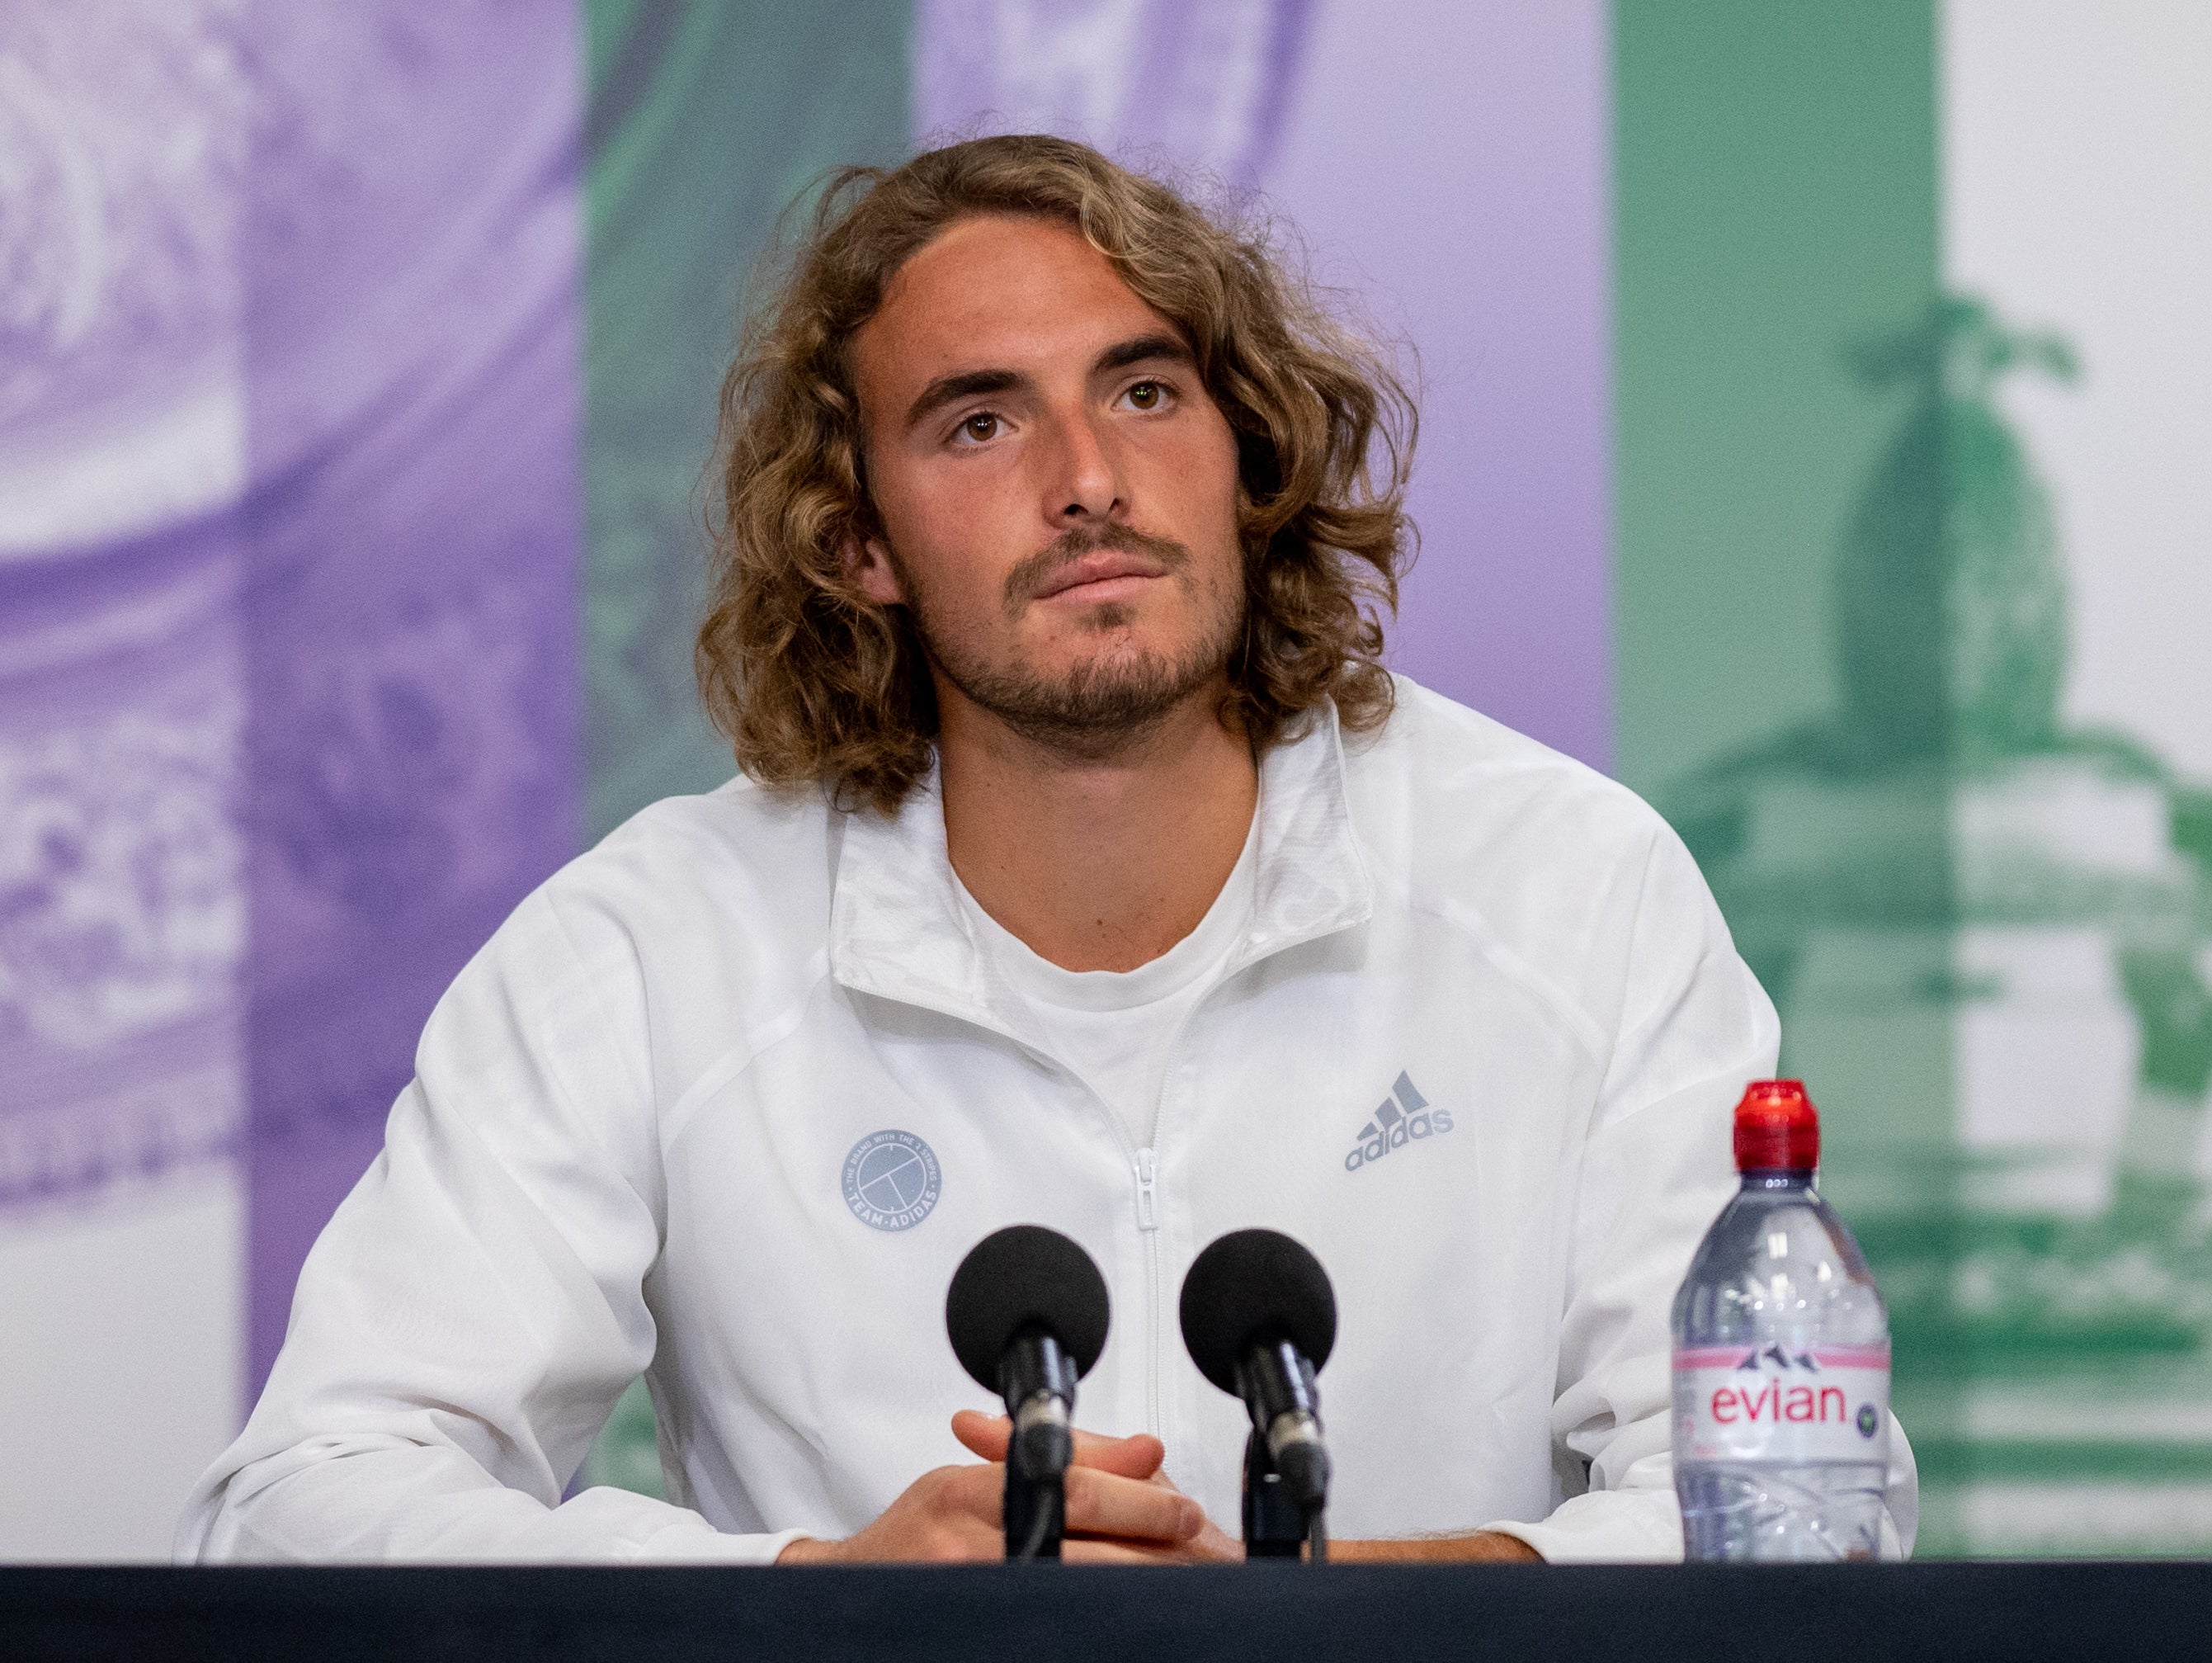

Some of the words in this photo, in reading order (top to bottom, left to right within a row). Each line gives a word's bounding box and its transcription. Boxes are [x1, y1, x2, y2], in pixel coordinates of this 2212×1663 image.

[847, 1168, 855, 1183] THE
[851, 1141, 872, 1165] BRAND
[875, 1134, 895, 1143] WITH
[898, 1134, 915, 1146] THE
[921, 1149, 937, 1181] STRIPES
[1345, 1108, 1454, 1172] adidas
[848, 1193, 884, 1225] TEAM
[889, 1190, 936, 1227] ADIDAS
[1710, 1377, 1846, 1424] evian
